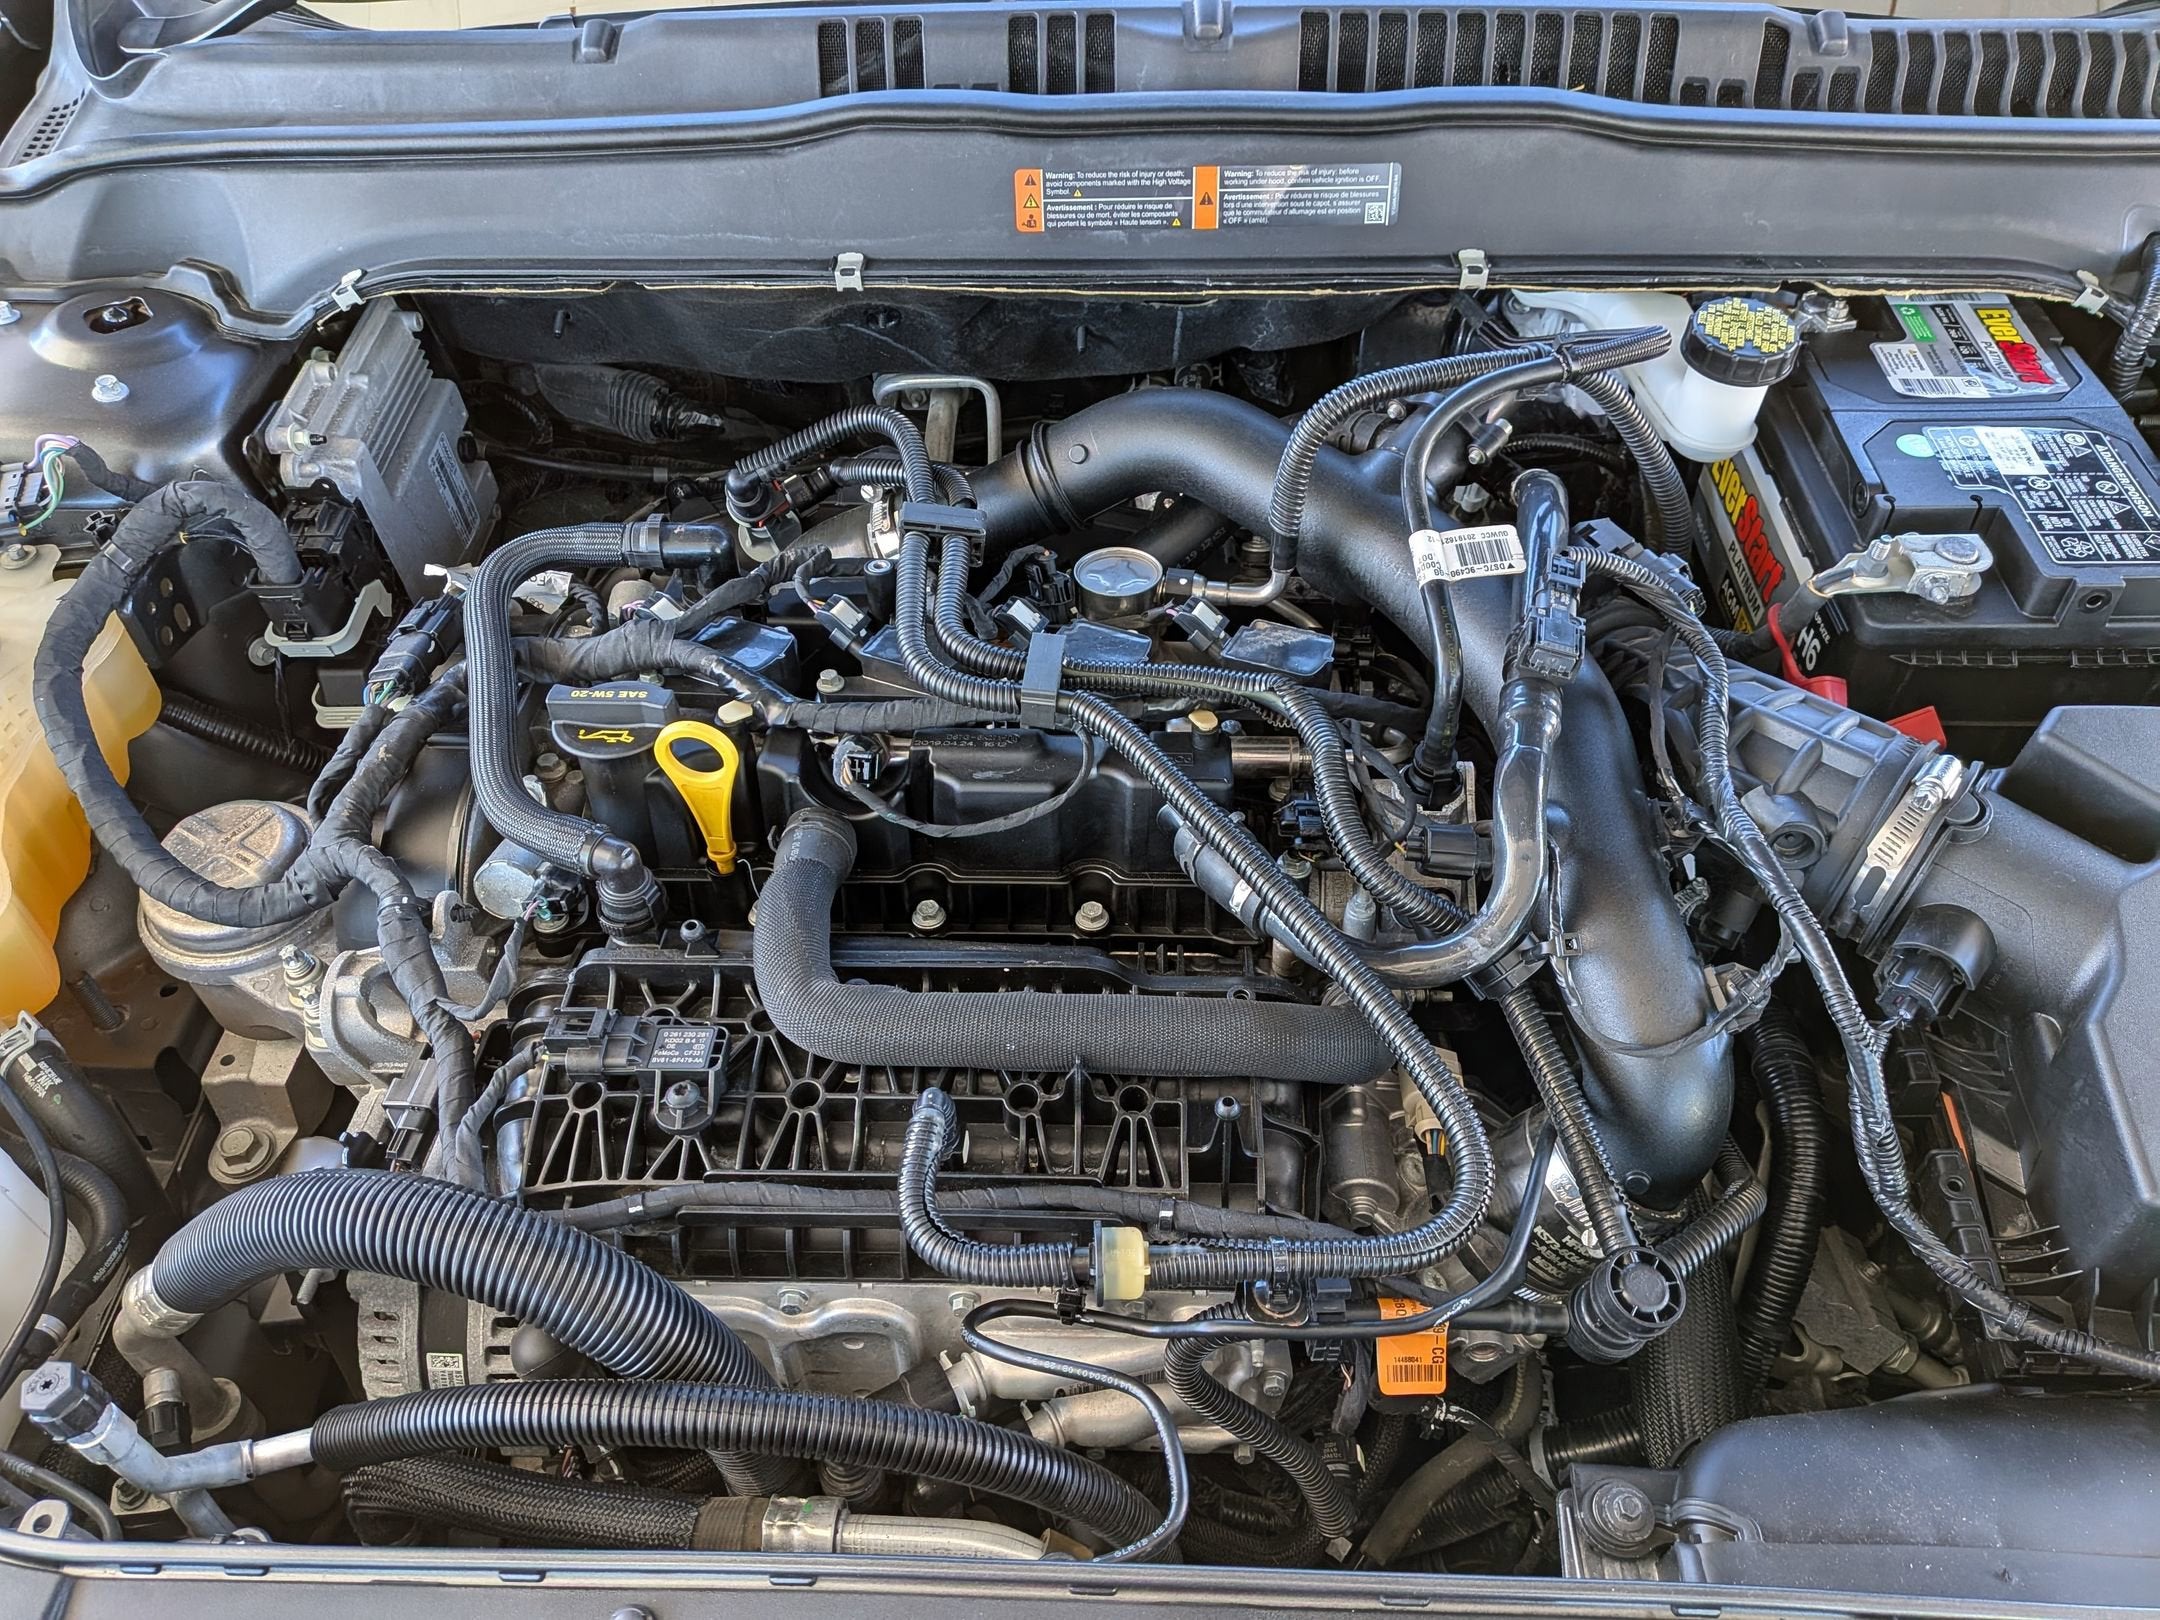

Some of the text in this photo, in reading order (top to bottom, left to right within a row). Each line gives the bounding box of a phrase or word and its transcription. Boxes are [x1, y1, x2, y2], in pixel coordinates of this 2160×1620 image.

[1046, 172, 1075, 180] Warning:
[1077, 172, 1083, 180] To
[1084, 171, 1106, 179] reduce
[1108, 171, 1118, 179] the
[1119, 171, 1129, 179] risk
[1131, 171, 1138, 179] of
[1140, 171, 1156, 179] injury
[1157, 171, 1164, 179] or
[1224, 170, 1254, 178] Warning:
[1256, 170, 1263, 178] To
[1311, 169, 1317, 177] of
[1339, 168, 1359, 176] before
[1046, 180, 1063, 188] avoid
[1065, 180, 1101, 188] components
[1103, 179, 1125, 187] marked
[1127, 179, 1139, 187] with
[1140, 179, 1150, 187] the
[1168, 178, 1191, 186] Voltage
[1224, 178, 1248, 186] working
[1312, 176, 1333, 184] vehicle
[1165, 202, 1172, 210] de
[1058, 220, 1079, 228] portent
[1080, 220, 1086, 228] le
[1139, 219, 1161, 227] tension
[1972, 308, 2059, 384] EverStart
[1979, 341, 2014, 377] PLATINUM
[2098, 451, 2155, 516] DANGER/POISON
[1728, 541, 1761, 618] PLATINUM
[1721, 578, 1739, 618] AGM
[1797, 625, 1821, 671] H6
[571, 689, 648, 698] SAE 5W-20
